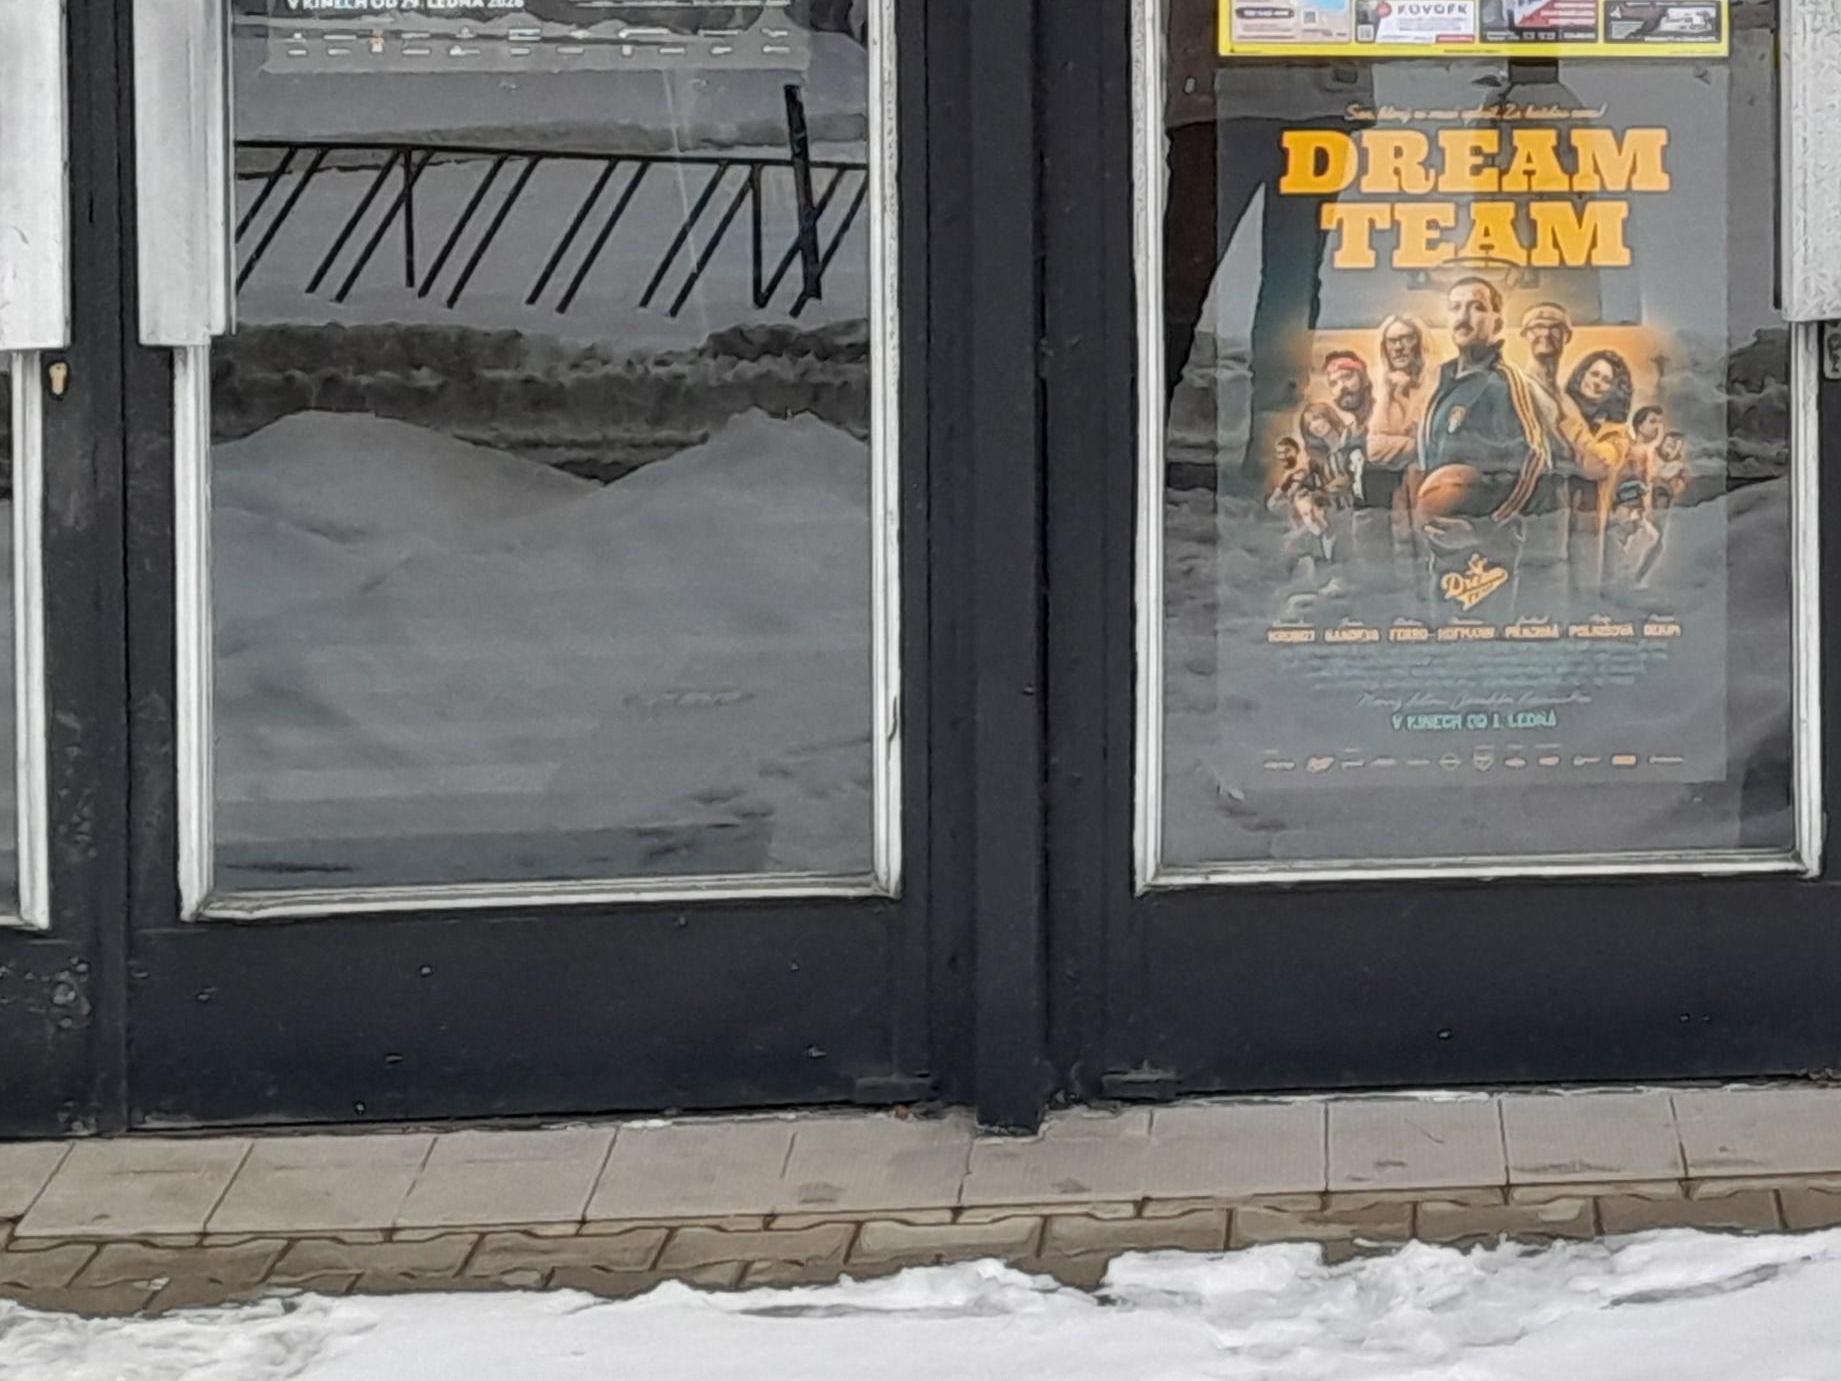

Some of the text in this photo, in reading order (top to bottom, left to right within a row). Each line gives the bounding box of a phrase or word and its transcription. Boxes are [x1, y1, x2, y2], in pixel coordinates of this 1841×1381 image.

[1279, 128, 1671, 195] DREAM
[1320, 200, 1632, 270] TEAM
[1406, 713, 1463, 730] KINECH
[1466, 713, 1488, 729] OD
[1507, 710, 1558, 728] LEDNA
